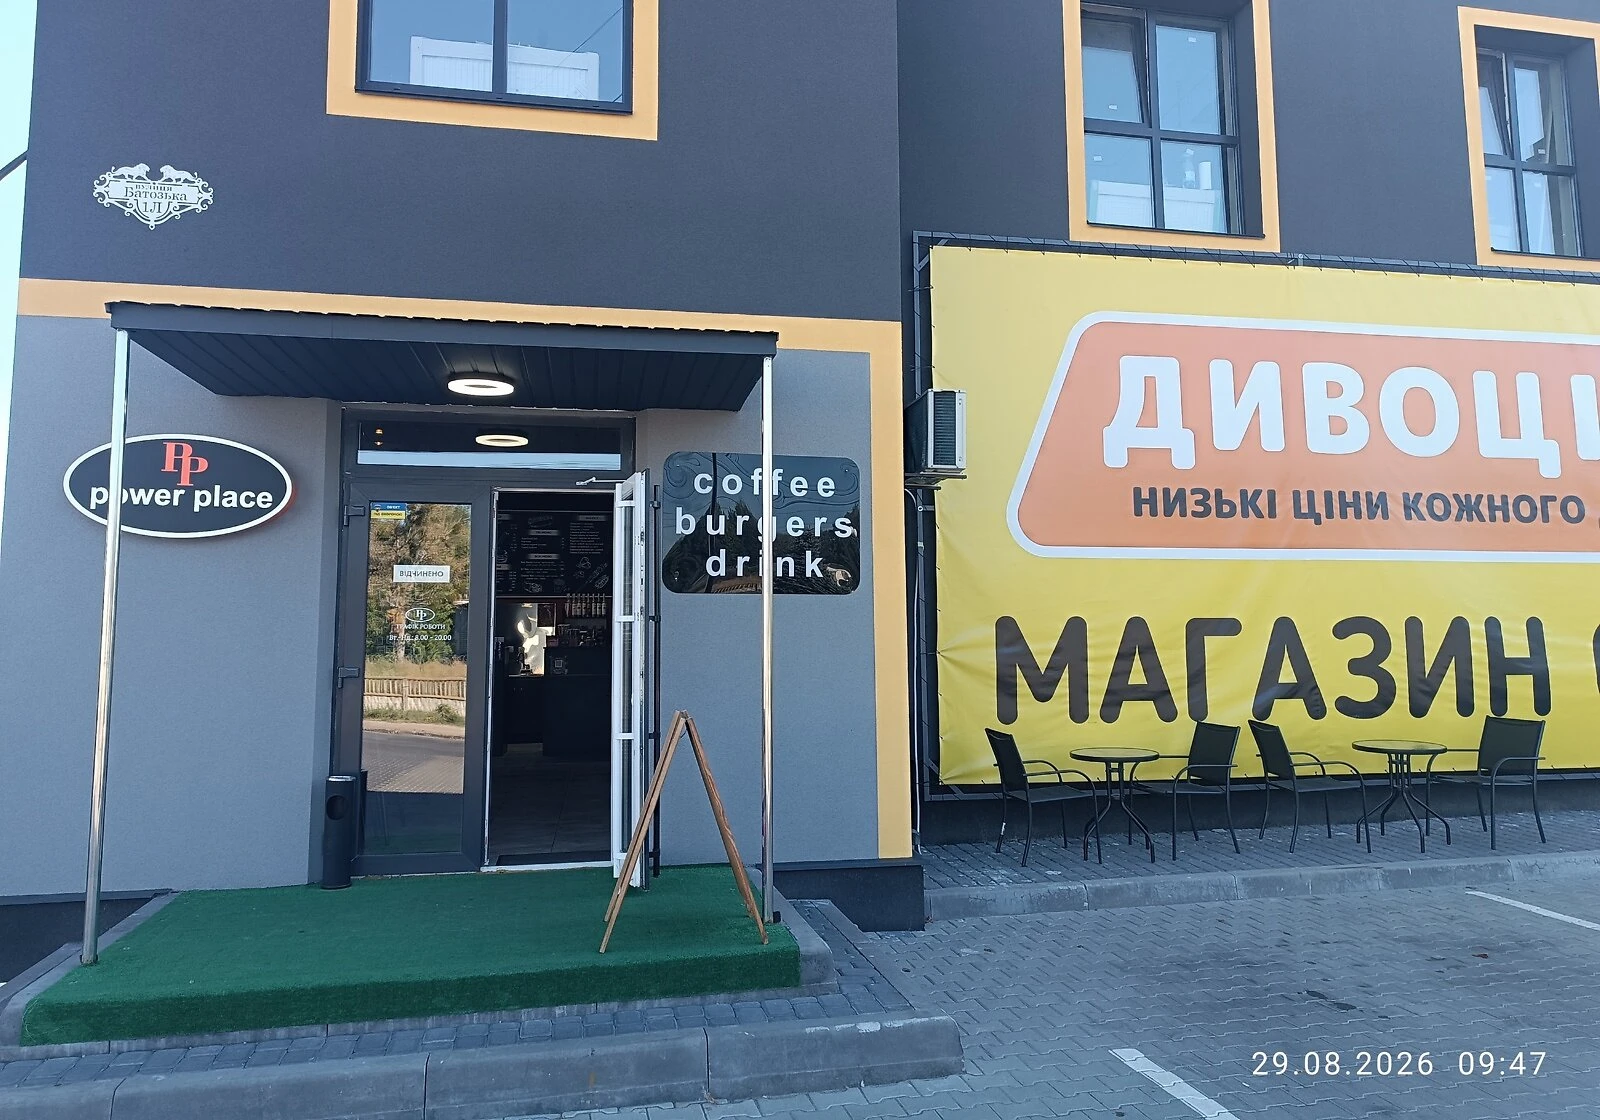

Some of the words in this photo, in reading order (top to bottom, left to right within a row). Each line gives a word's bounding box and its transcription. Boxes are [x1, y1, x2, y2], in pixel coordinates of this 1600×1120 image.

[124, 186, 188, 201] Батозька
[143, 201, 162, 213] 1Л
[1102, 355, 1600, 478] ДИВОЦІ
[693, 467, 836, 498] coffee
[193, 484, 273, 513] place
[1132, 486, 1278, 519] НИЗЬКІ
[1292, 488, 1390, 526] ЦІНИ
[1403, 492, 1586, 524] КОЖНОГО
[399, 570, 444, 578] ВІДЧИНЕНО
[705, 548, 823, 578] drink
[995, 615, 1551, 725] МАГАЗИН
